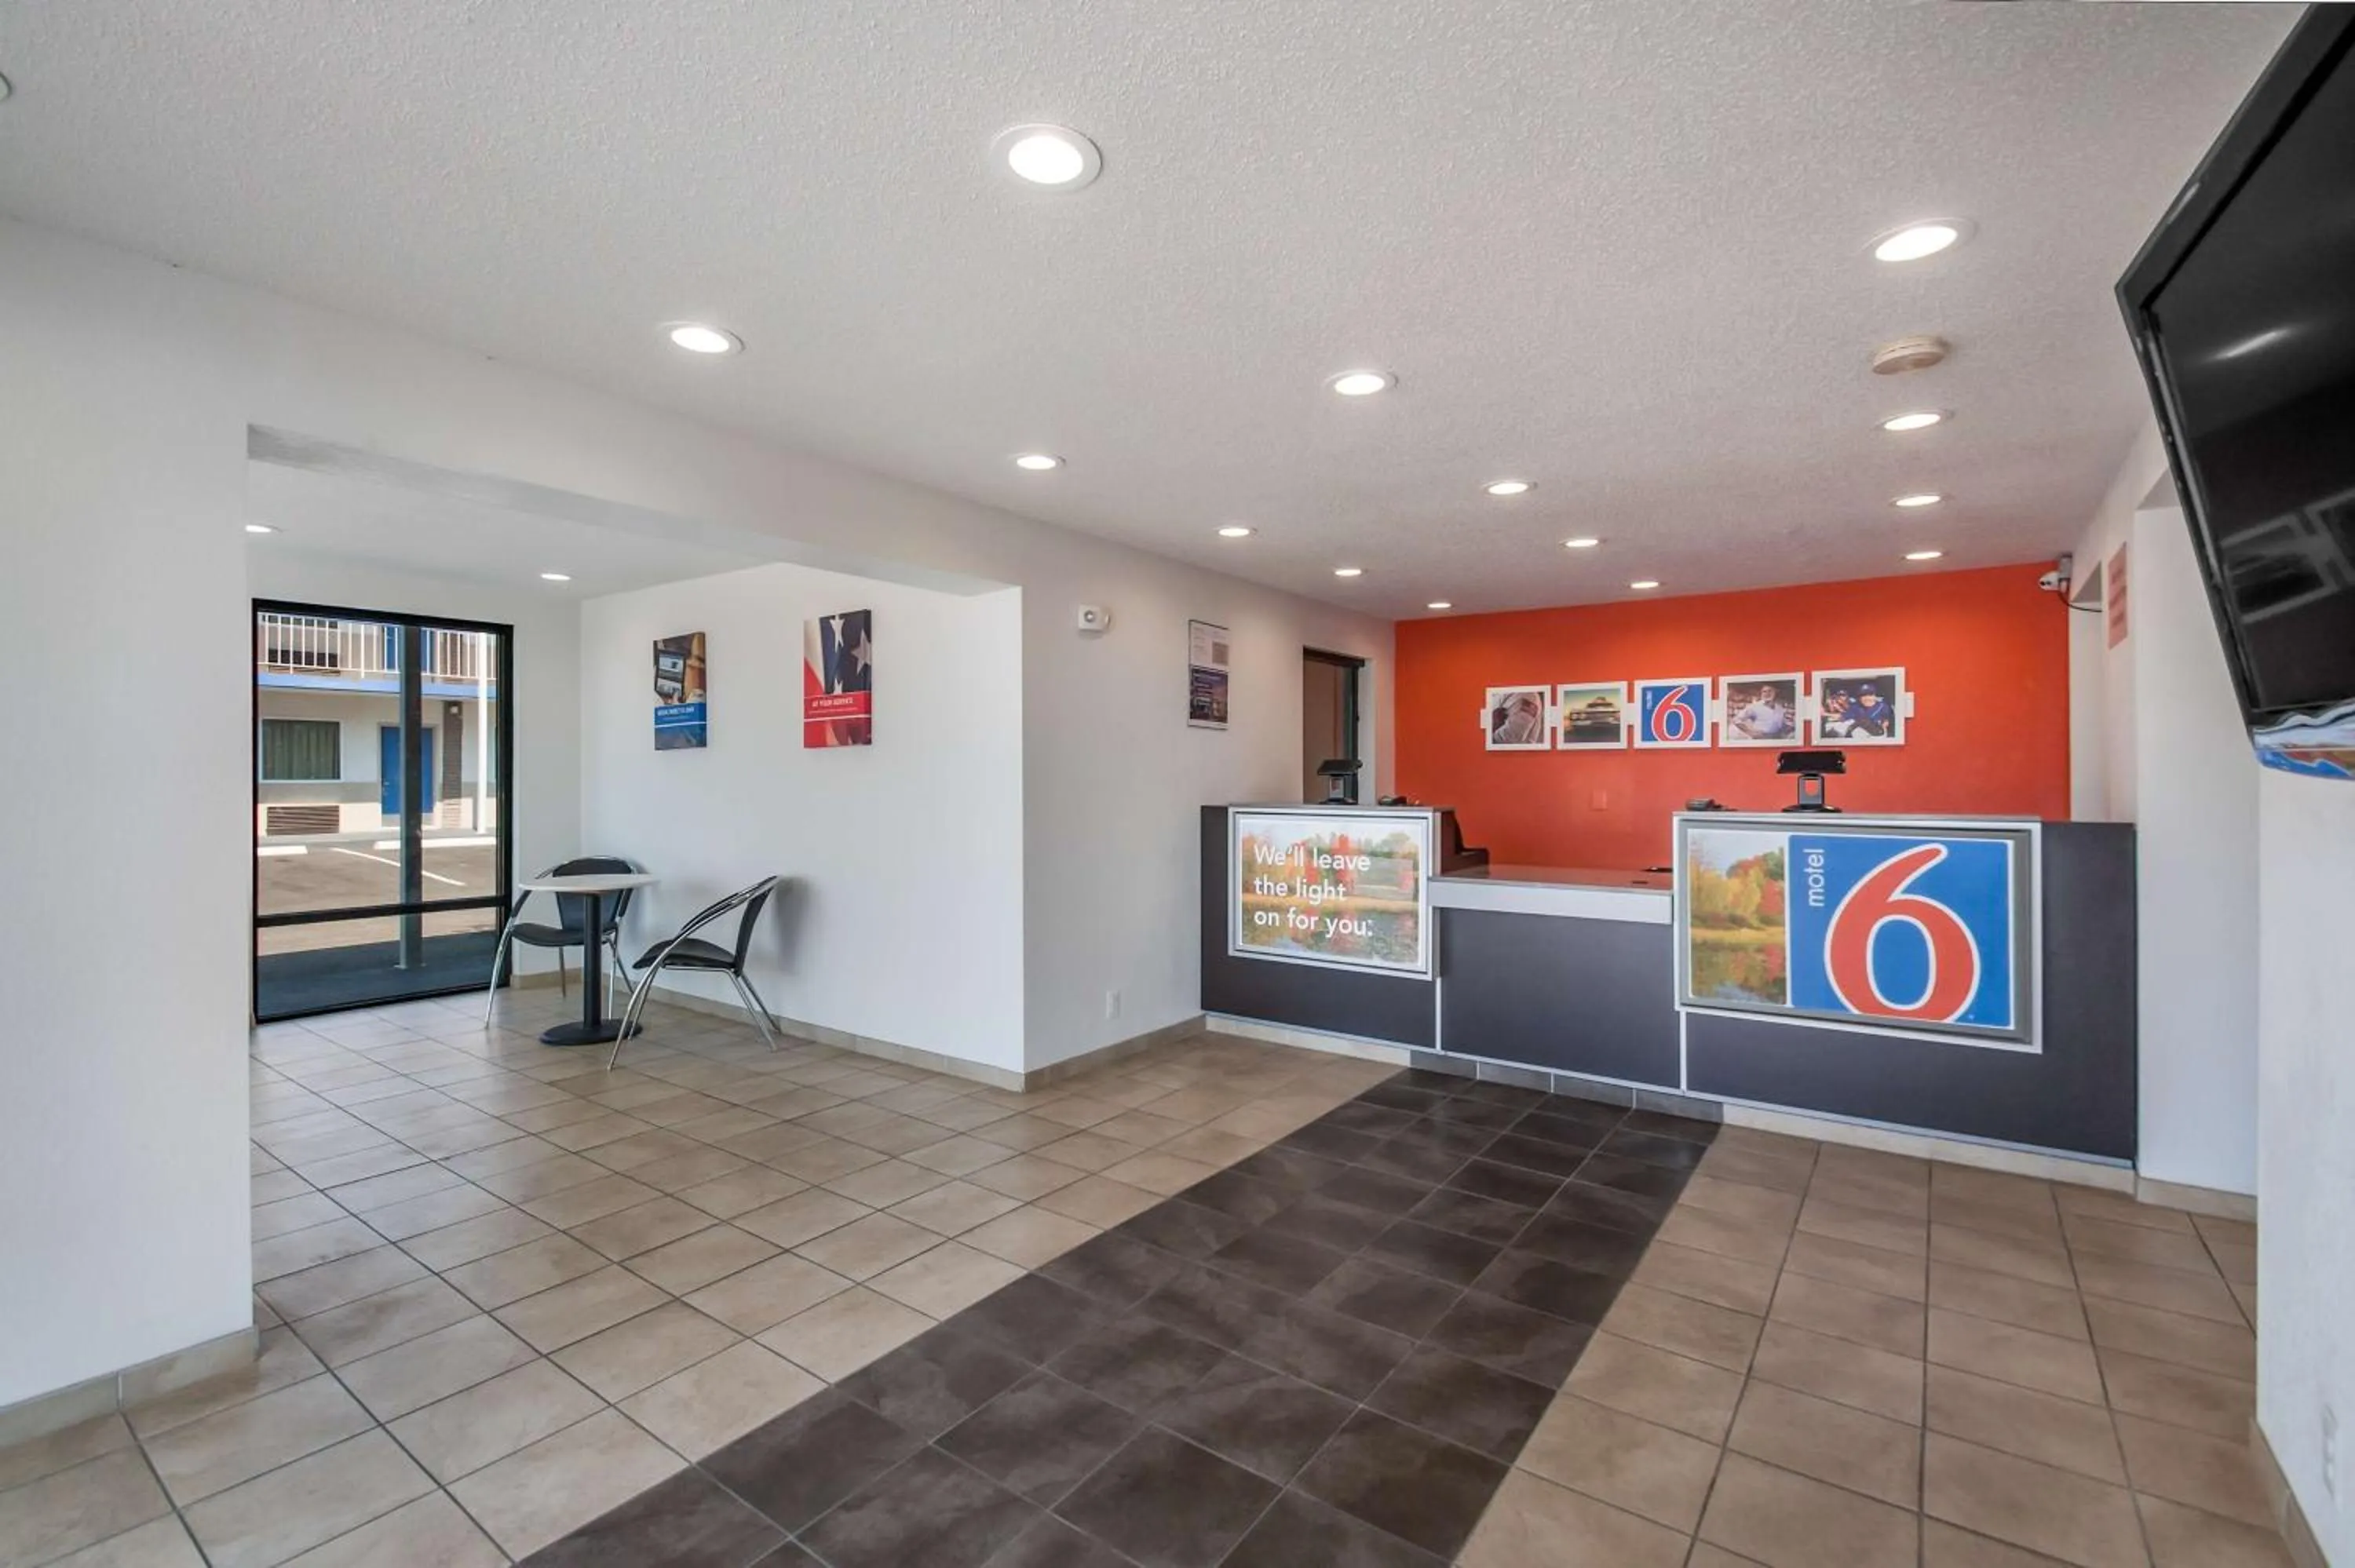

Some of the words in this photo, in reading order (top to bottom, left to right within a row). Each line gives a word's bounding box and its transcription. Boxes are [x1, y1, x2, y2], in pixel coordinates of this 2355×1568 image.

[1651, 685, 1696, 742] 6
[1254, 844, 1305, 867] We'll
[1313, 848, 1371, 871] leave
[1254, 874, 1288, 896] the
[1296, 877, 1347, 905] light
[1254, 910, 1280, 926] on
[1287, 907, 1319, 930] for
[1802, 848, 1825, 906] motel
[1824, 842, 1981, 1023] 6
